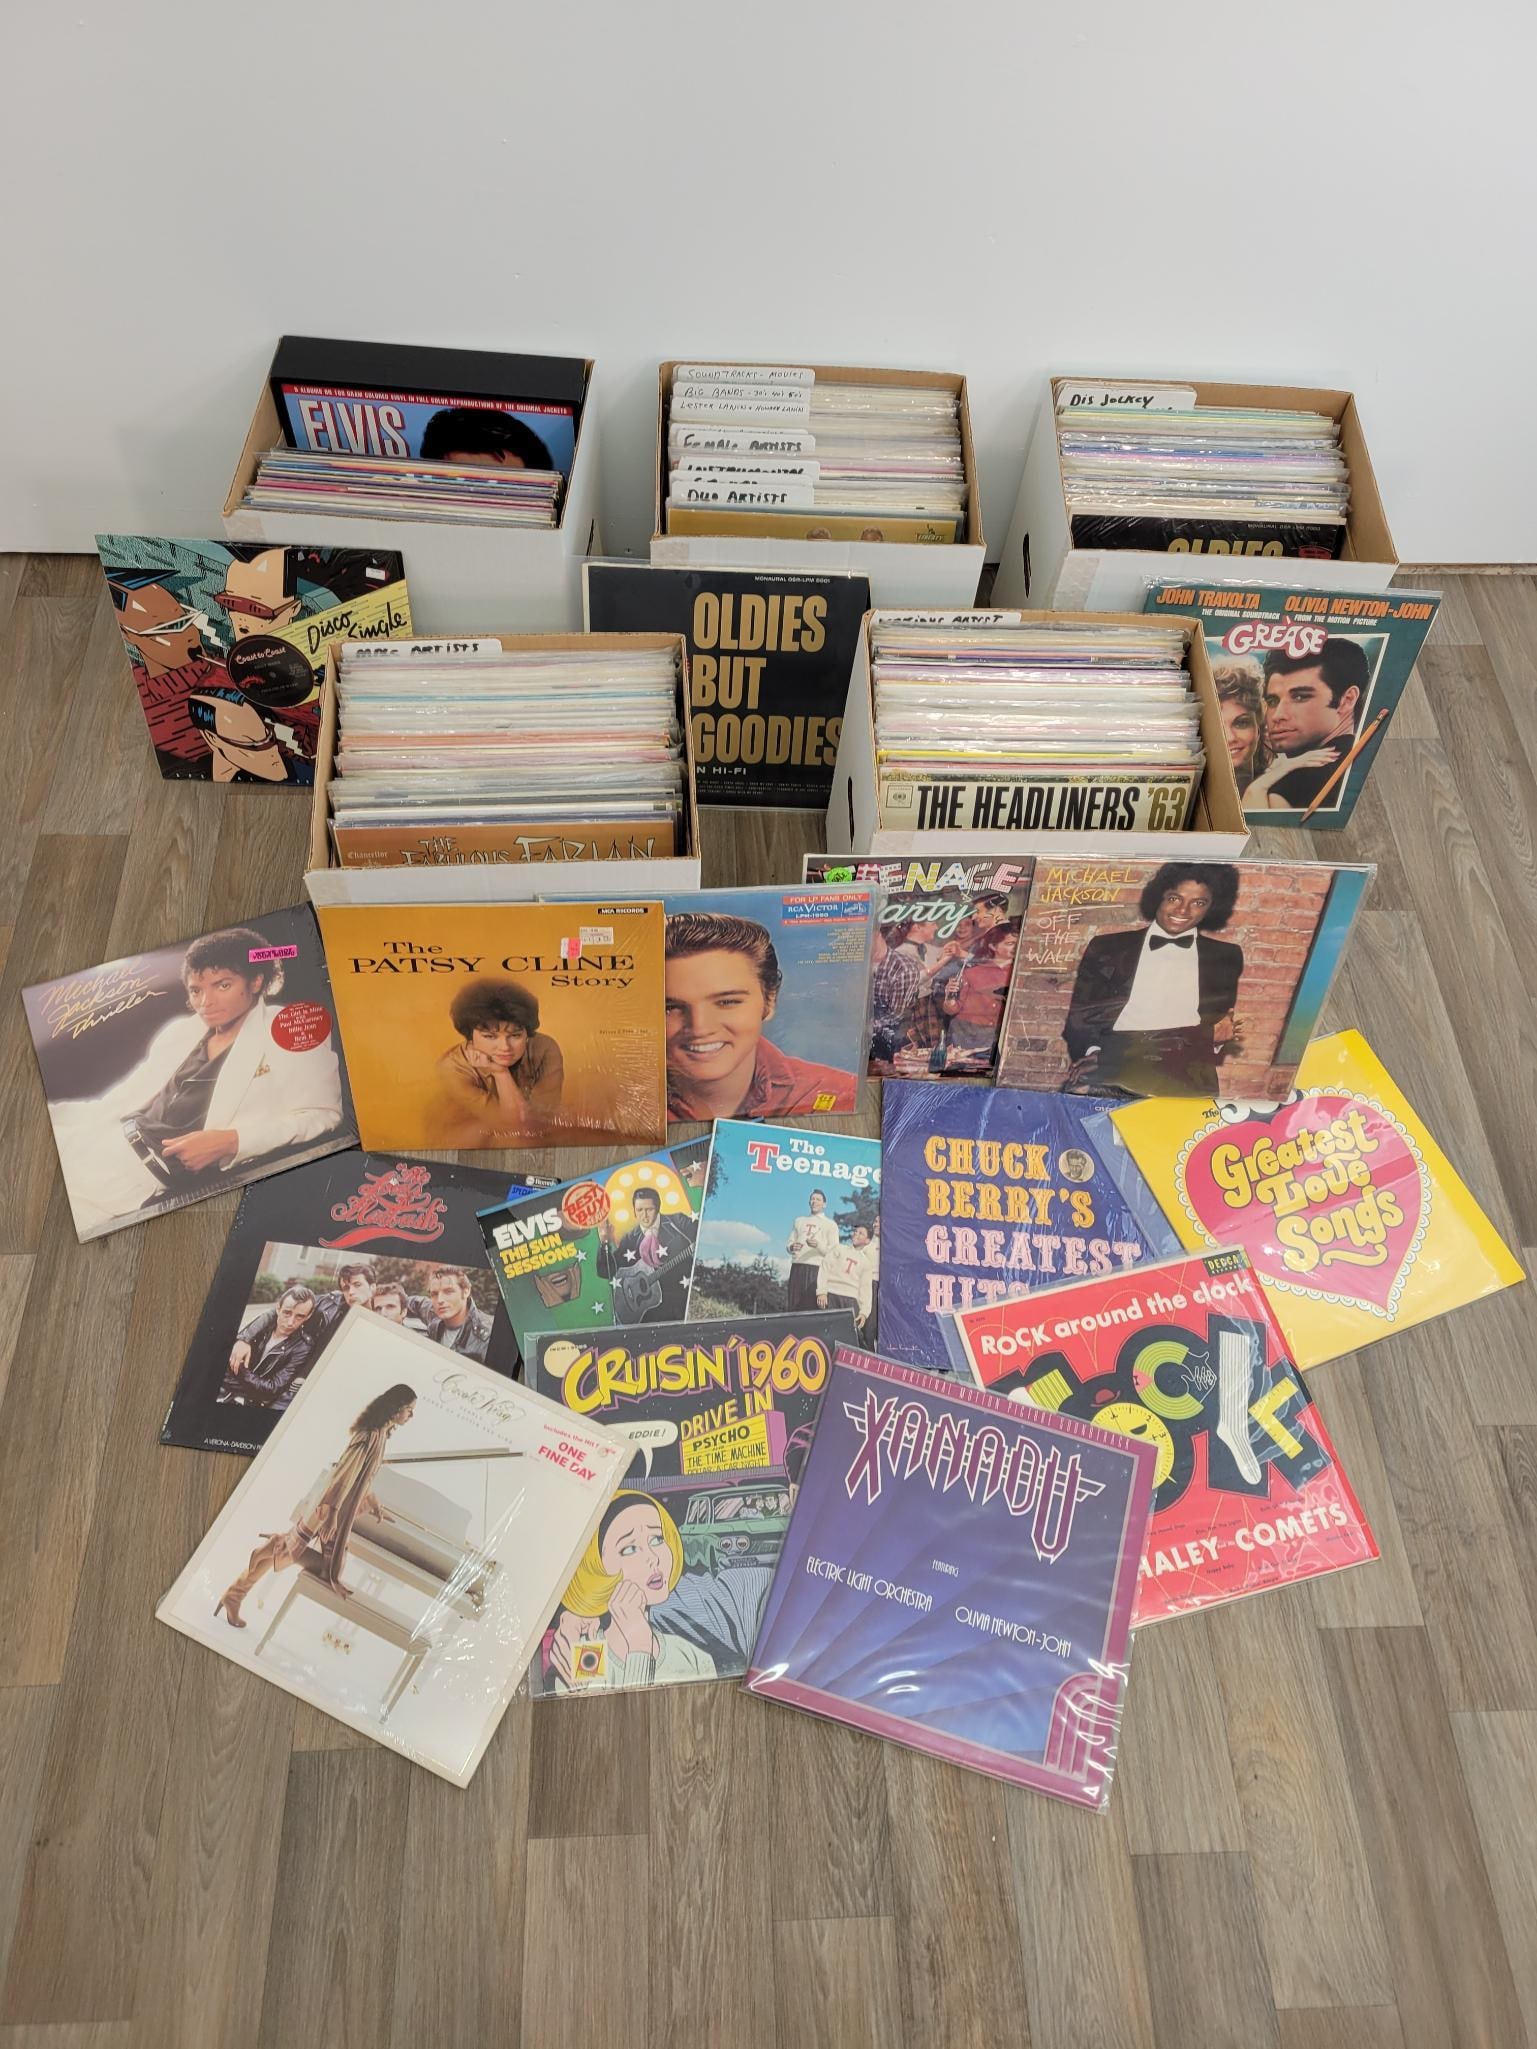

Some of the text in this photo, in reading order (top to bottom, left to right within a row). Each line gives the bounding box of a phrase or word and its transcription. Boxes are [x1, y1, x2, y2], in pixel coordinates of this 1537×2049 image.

[297, 399, 409, 458] ELVIS
[692, 592, 828, 653] OLDIES
[1156, 588, 1434, 621] JOHN TRAVOLTA OLIVIA NEWTON-JOHN
[1201, 608, 1378, 627] THE ORIGINAL SOUNDTRACK FROM THE MOTION PICTURE
[307, 610, 353, 655] Disco
[1227, 622, 1328, 660] GREASE
[691, 654, 768, 710] BUT
[691, 713, 844, 768] GOODIES
[712, 766, 747, 777] HI-FI
[916, 785, 1187, 832] THE HEADLINERS '63
[1045, 865, 1140, 885] MICHAEL
[788, 903, 840, 914] RCA VICTOR
[790, 896, 806, 904] FOR
[820, 895, 840, 903] FANS
[842, 894, 863, 902] ONLY
[1040, 886, 1122, 906] JACKSON
[1036, 912, 1083, 931] OFF
[1039, 931, 1082, 946] THE
[347, 954, 636, 974] PATSY CLINE
[383, 941, 444, 955] The
[1025, 948, 1075, 966] WALL
[40, 962, 152, 1016] Michael
[551, 974, 634, 990] Story
[1202, 1107, 1219, 1119] The
[789, 1137, 826, 1157] The
[923, 1135, 1050, 1182] CHUCK
[1208, 1109, 1380, 1209] Greatest
[925, 1178, 1096, 1229] BERRY'S
[1256, 1157, 1372, 1219] Love
[492, 1207, 563, 1252] ELVIS
[499, 1232, 563, 1267] THE SUN
[1276, 1186, 1406, 1274] Songs
[503, 1241, 578, 1281] SESSIONS
[925, 1224, 1142, 1277] GREATEST
[1207, 1253, 1240, 1271] DECCA
[981, 1272, 1256, 1357] ROCK around the clock
[562, 1336, 826, 1420] CRUISIN' 1960
[840, 1349, 871, 1369] FROM
[876, 1359, 895, 1374] THE
[959, 1386, 1002, 1410] MOTION
[1006, 1401, 1053, 1427] PICTURE
[680, 1384, 773, 1441] DRIVE IN
[558, 1441, 588, 1464] ONE
[687, 1441, 767, 1469] THE TIME MACHINE
[692, 1425, 751, 1452] PSYCHO
[537, 1445, 598, 1482] FINE DAY
[843, 1387, 1107, 1565] XANADU
[1234, 1502, 1349, 1553] COMETS
[805, 1555, 934, 1613] ELECTRIC LIGHT ORCHESTRA
[954, 1605, 1073, 1660] OLIVIA NEWTON-JOHN
